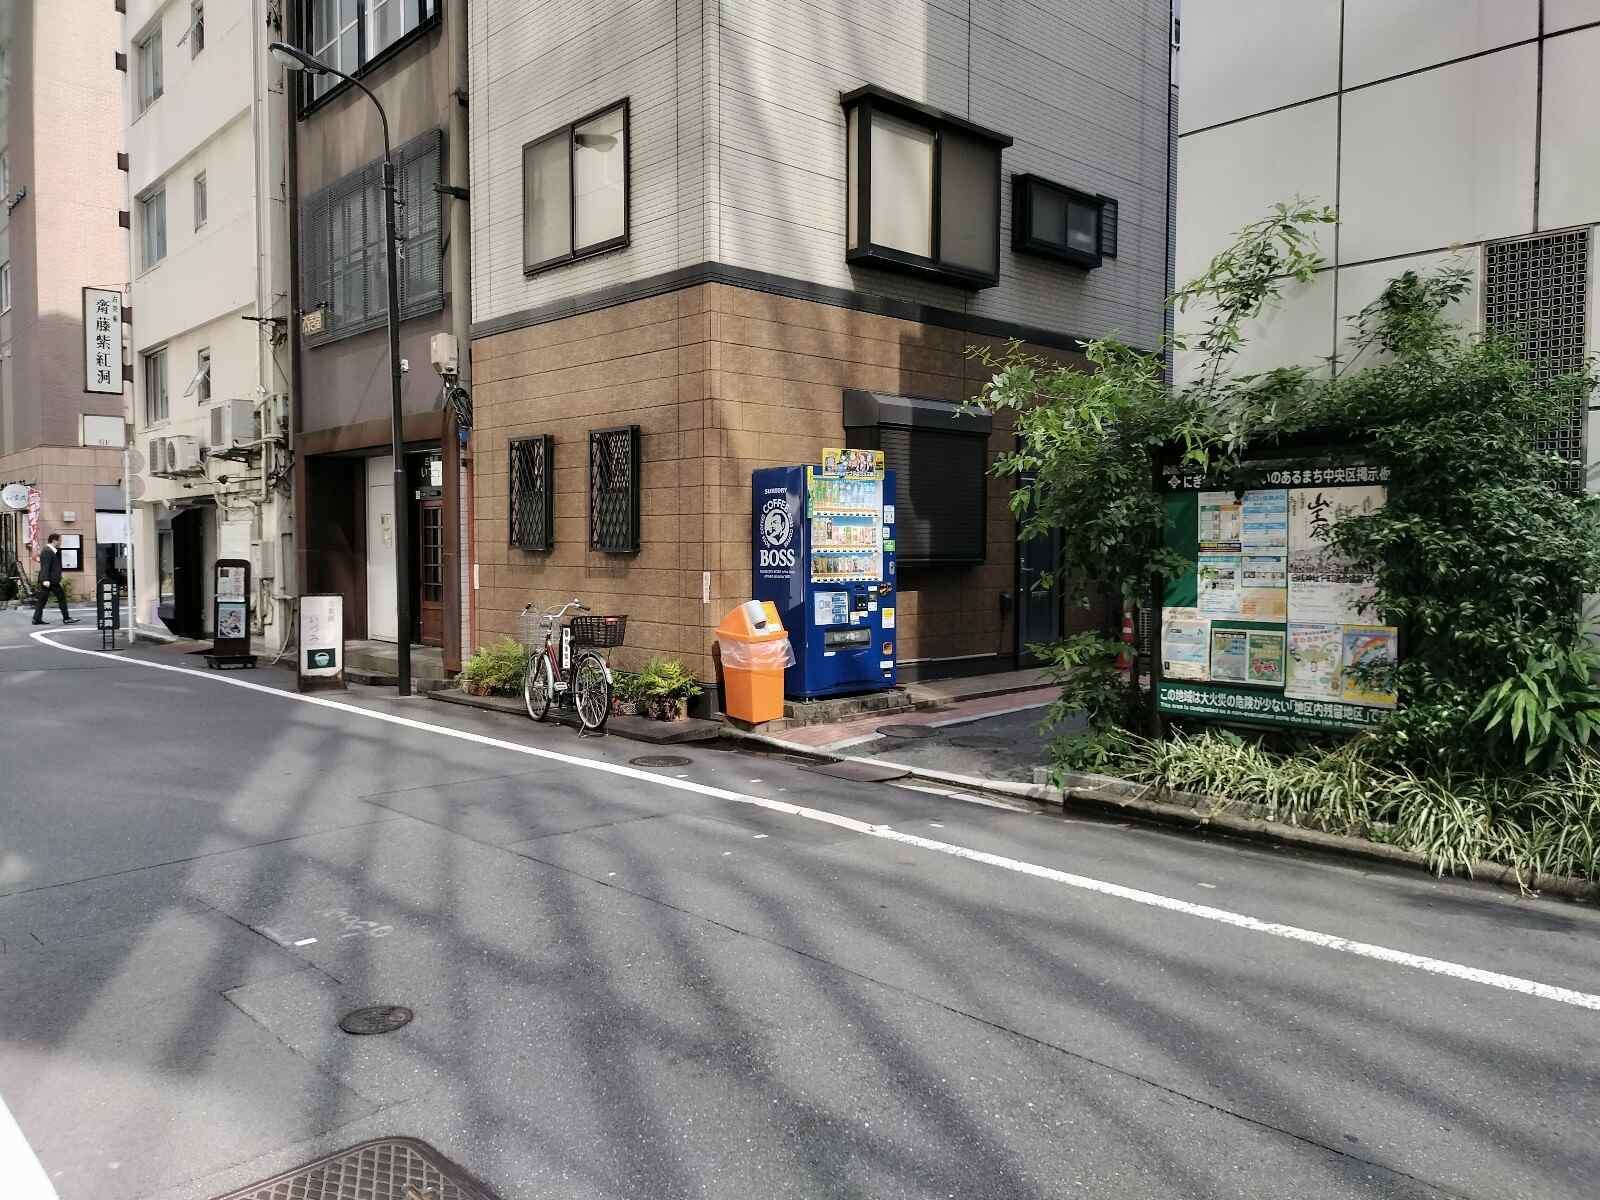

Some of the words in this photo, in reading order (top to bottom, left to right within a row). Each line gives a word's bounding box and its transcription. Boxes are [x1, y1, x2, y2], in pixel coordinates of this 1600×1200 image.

[1183, 466, 1391, 489] にぎいのあるまち中央区掲示板
[764, 487, 788, 495] SUNTORY
[763, 498, 790, 513] COFFEE
[760, 548, 796, 567] BOSS
